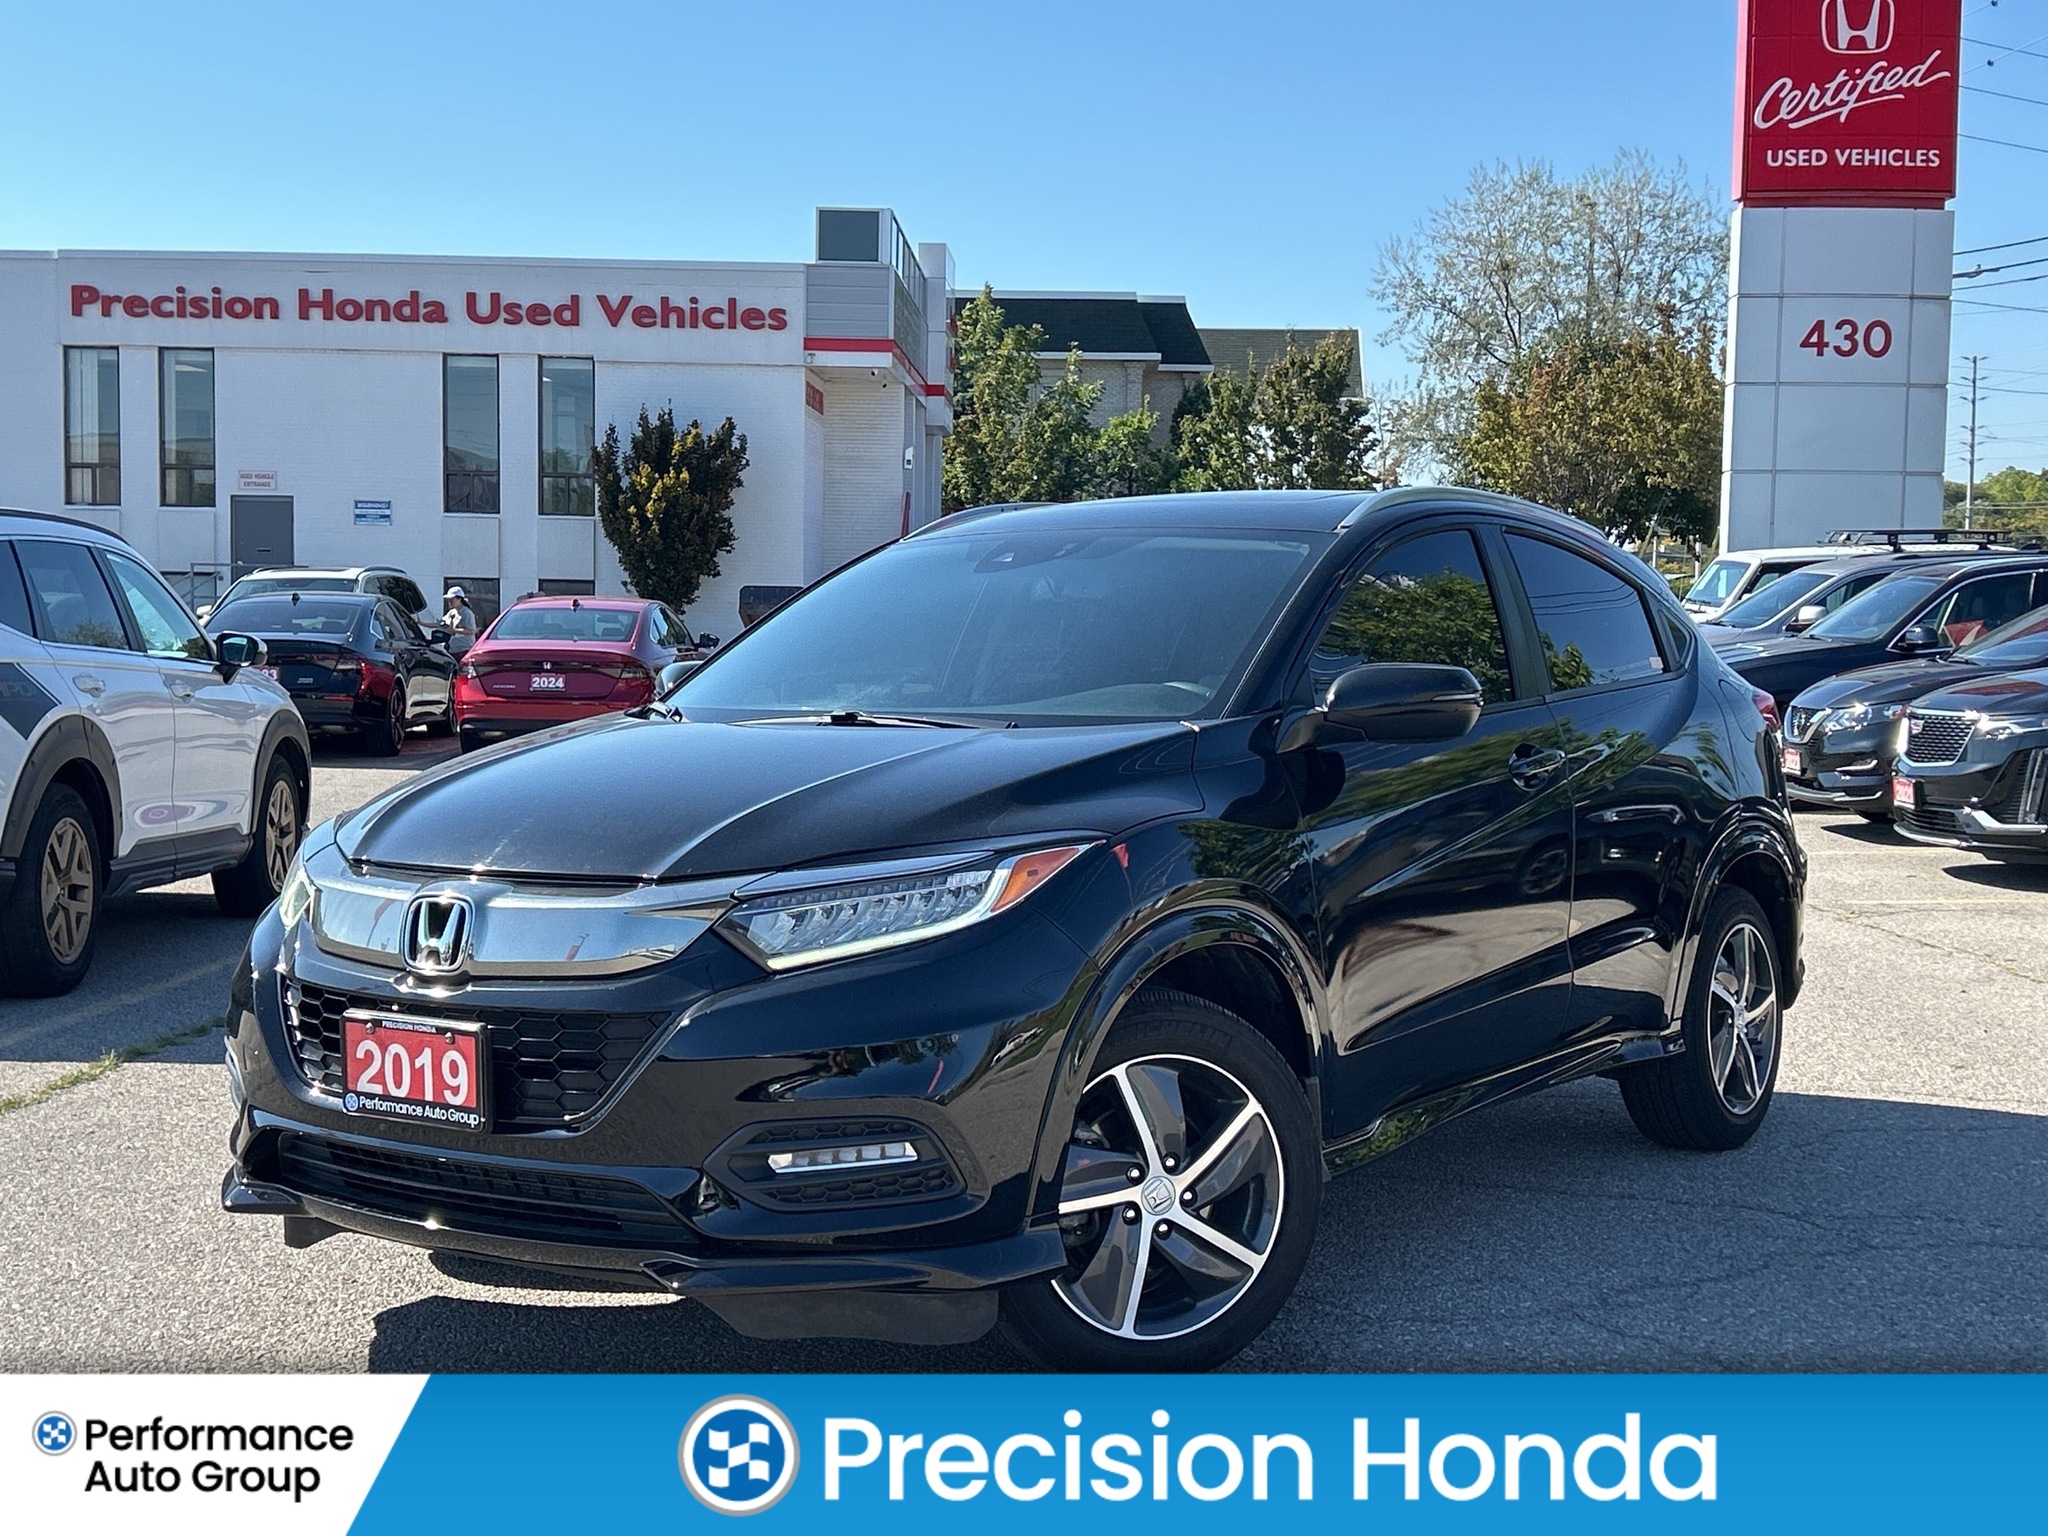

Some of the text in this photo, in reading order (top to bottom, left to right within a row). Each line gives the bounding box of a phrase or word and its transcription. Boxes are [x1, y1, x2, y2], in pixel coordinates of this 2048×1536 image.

[1754, 50, 1951, 129] Certified
[1766, 149, 1940, 167] USED VEHICLES
[71, 285, 788, 330] Precision Honda Used Vehicles
[1799, 318, 1893, 358] 430
[532, 677, 564, 688] 2024
[382, 1020, 437, 1034] PRECISION HONDA
[356, 1039, 469, 1106] 2019
[359, 1096, 479, 1128] Performance Auto Group
